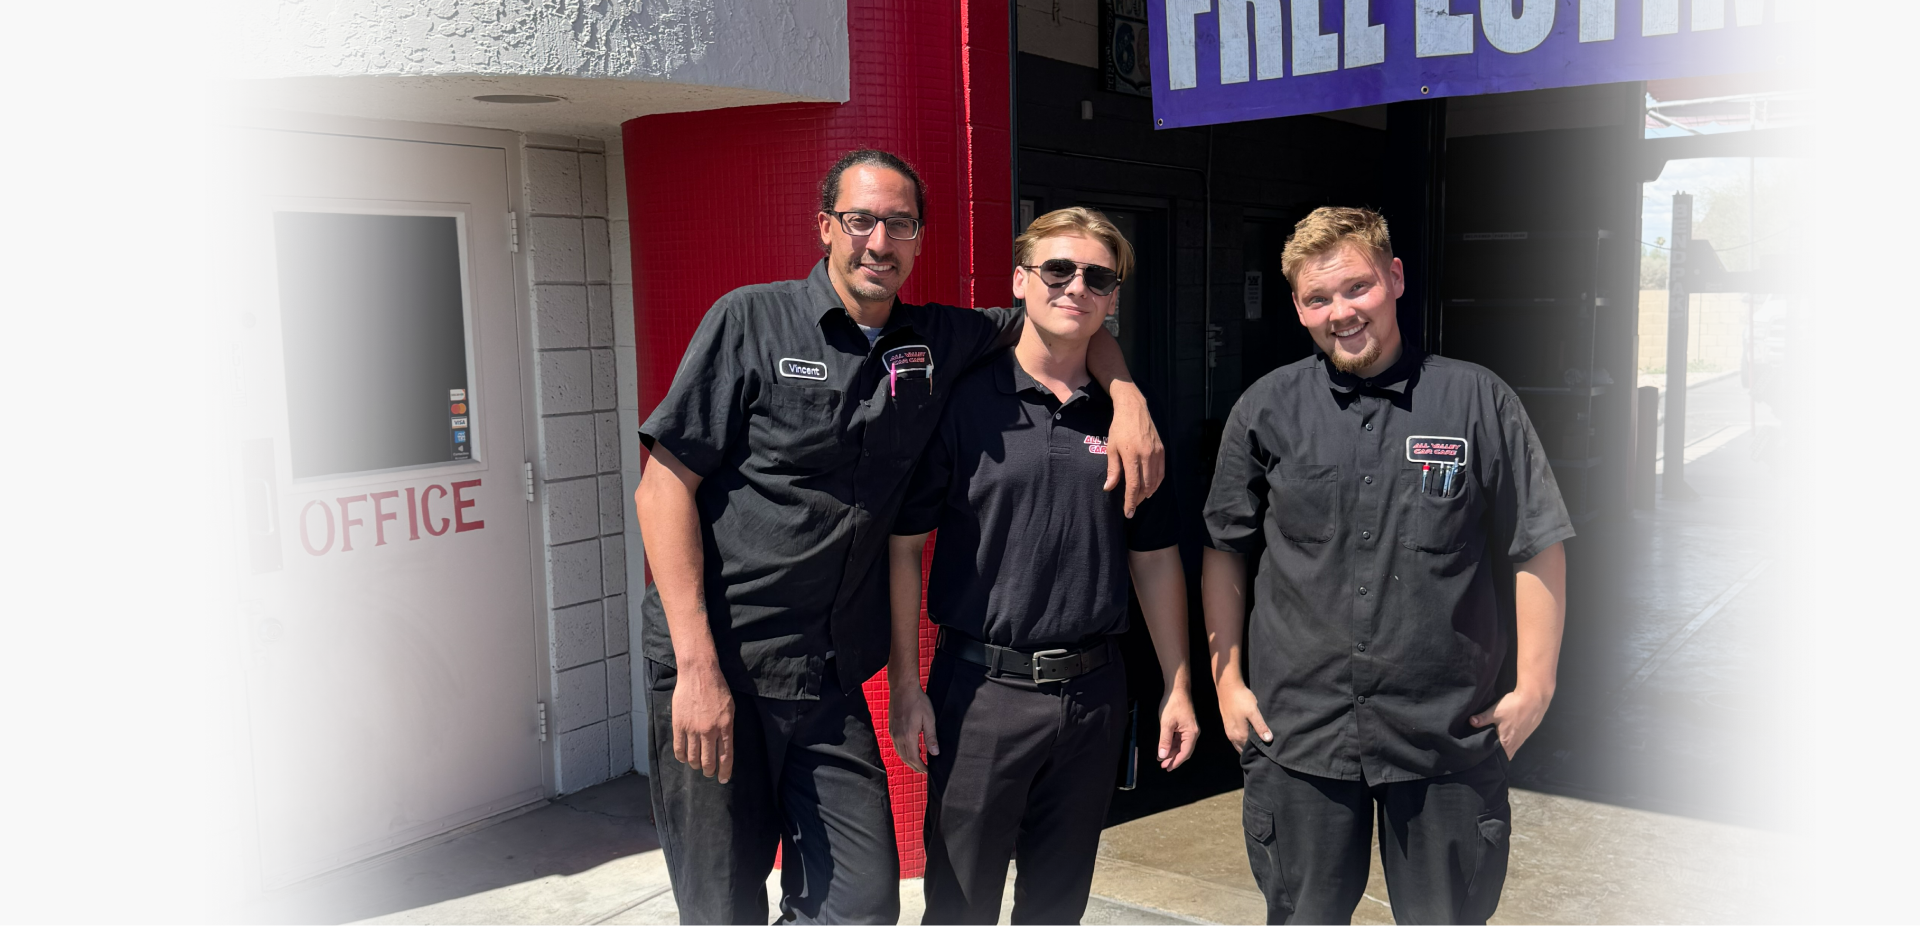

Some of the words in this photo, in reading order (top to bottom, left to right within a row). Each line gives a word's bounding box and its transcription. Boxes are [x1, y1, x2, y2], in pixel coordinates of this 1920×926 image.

[1671, 203, 1687, 312] BENDPAK
[231, 343, 243, 392] PULL
[789, 363, 820, 377] Vincent
[1084, 435, 1101, 444] ALL
[299, 478, 485, 557] OFFICE
